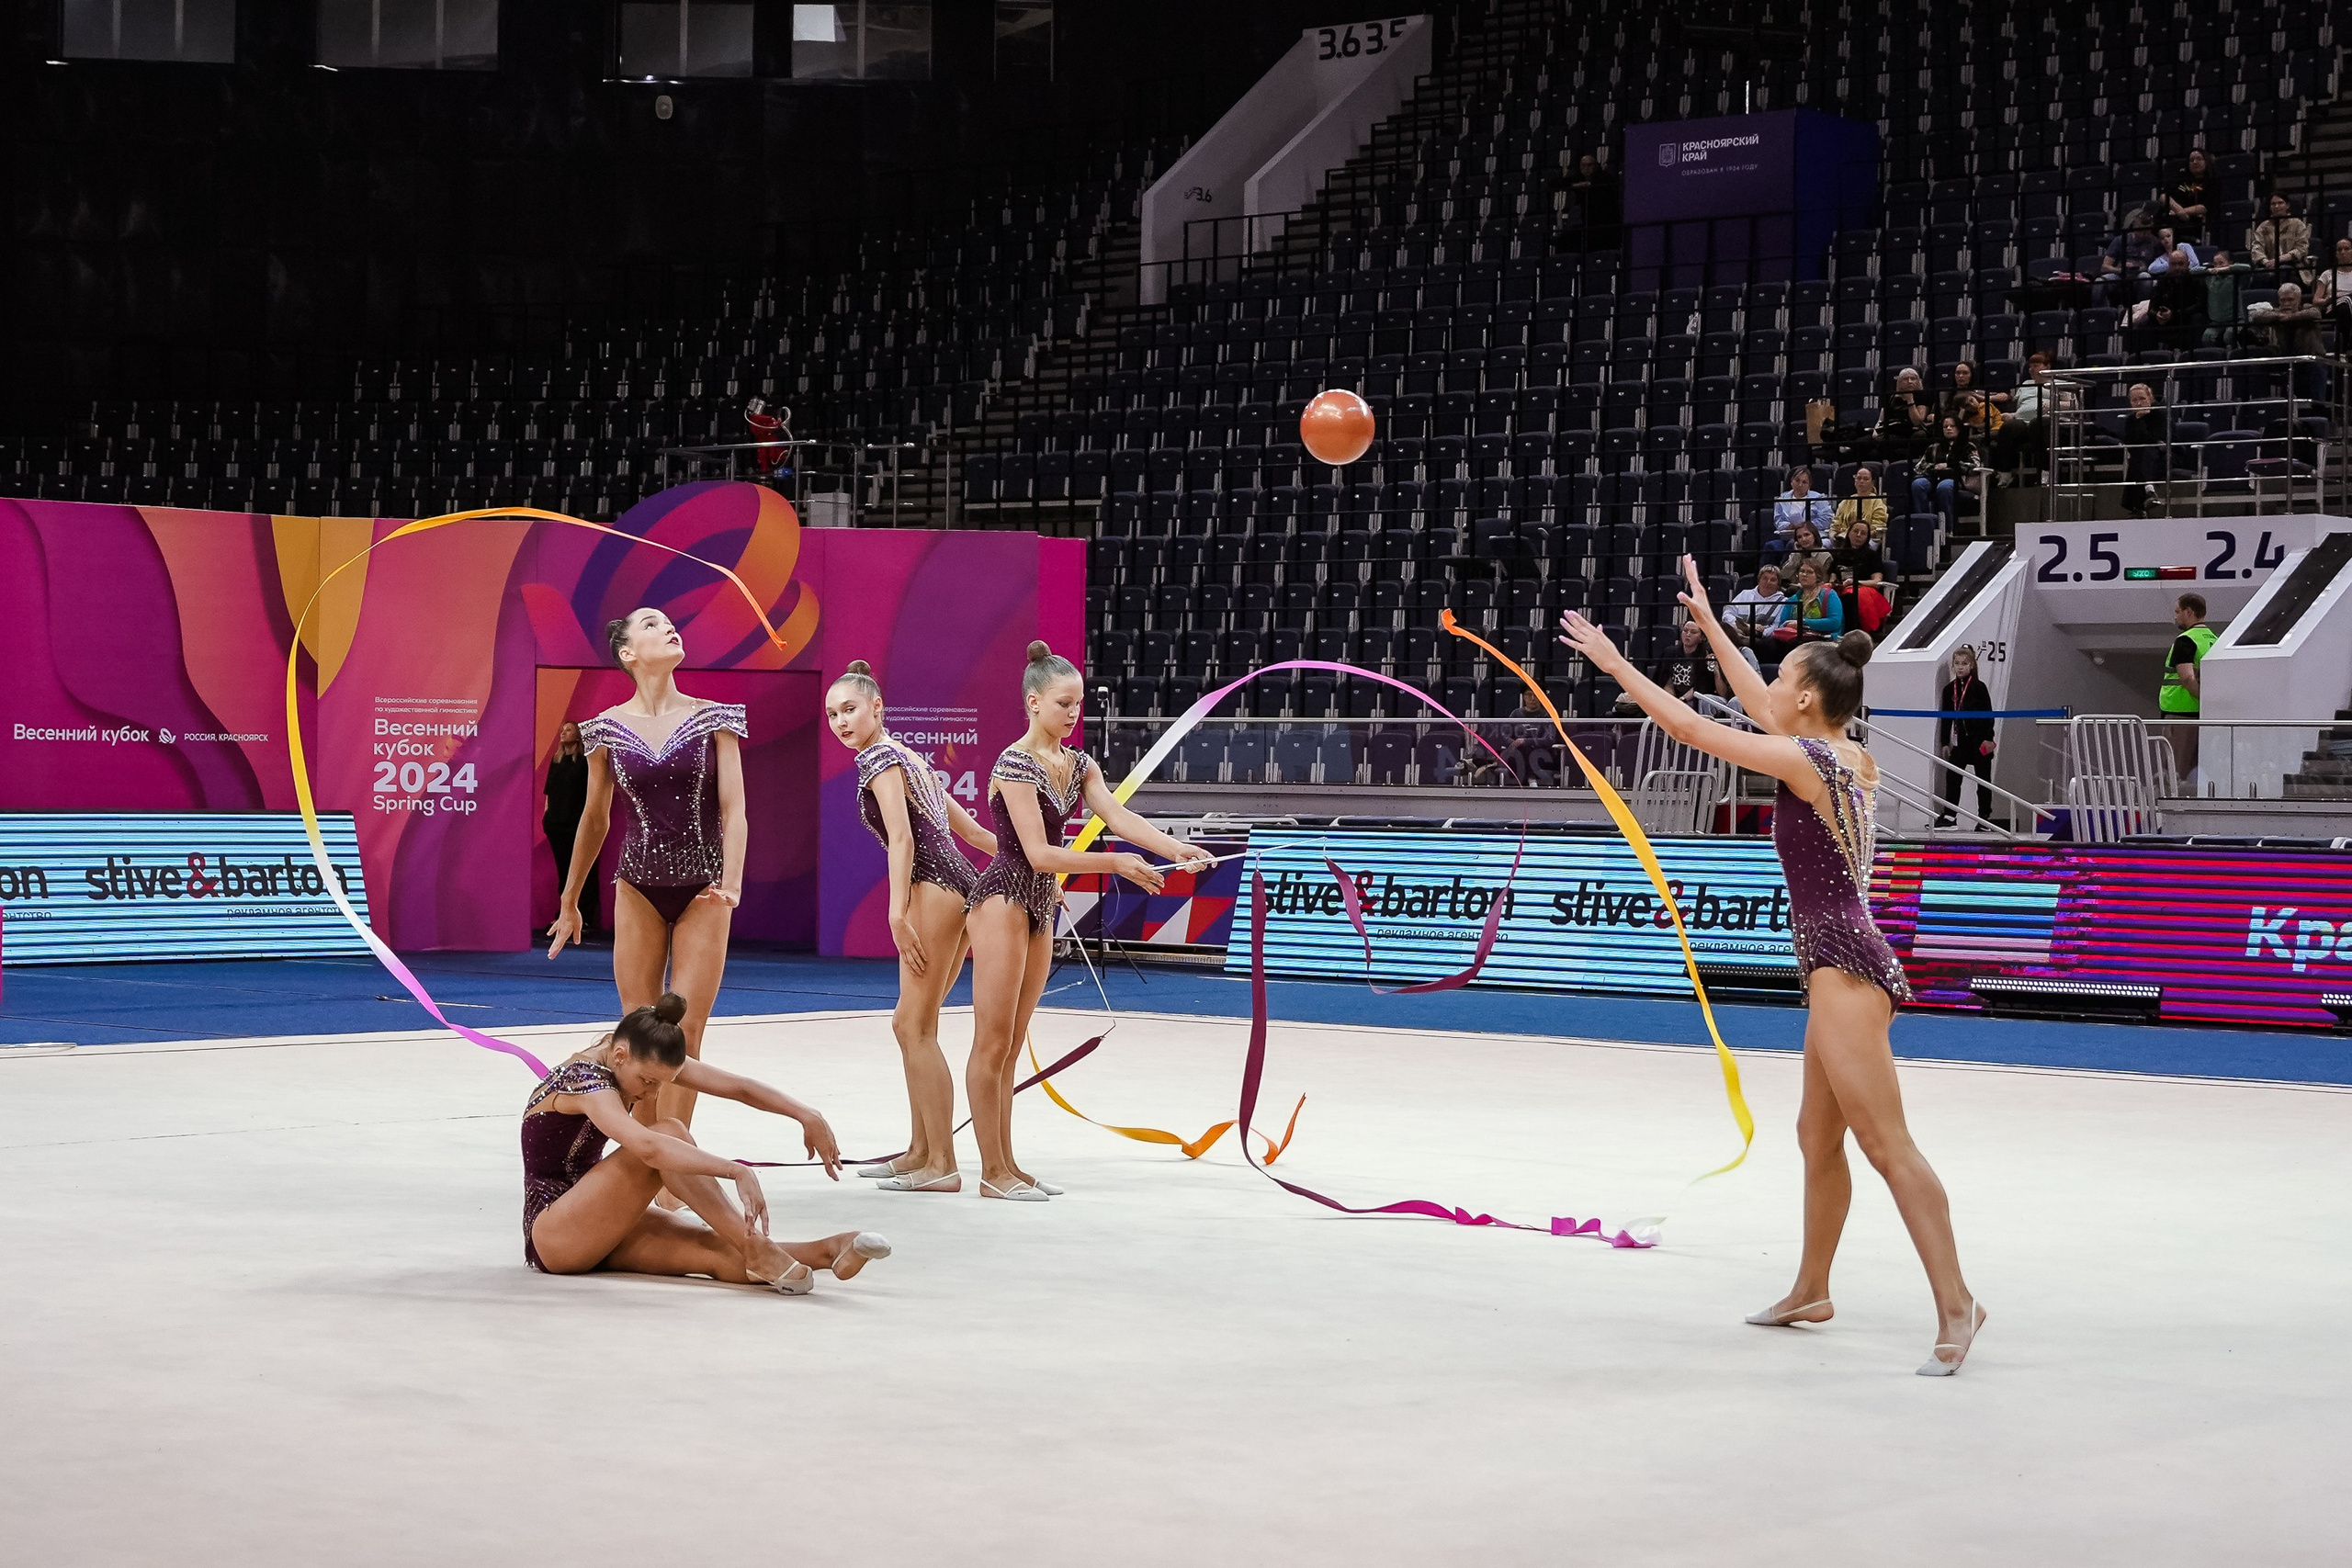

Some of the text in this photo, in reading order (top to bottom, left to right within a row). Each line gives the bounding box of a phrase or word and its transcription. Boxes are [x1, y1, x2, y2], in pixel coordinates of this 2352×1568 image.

[1318, 25, 1361, 61] 3.6
[1682, 133, 1759, 152] КРАСНОЯРСКИЙ
[1681, 150, 1707, 163] КРАЙ
[2037, 532, 2120, 584] 2.5
[2204, 530, 2285, 581] 2.4
[375, 696, 427, 705] Всероссийские
[13, 723, 150, 746] Весенний кубок
[184, 733, 269, 742] РОССИЯ, КРАСНОЯРСК
[374, 717, 478, 737] Весенний
[373, 739, 435, 761] кубок
[373, 761, 479, 794] 2024
[372, 795, 478, 817] Spring Cup
[84, 852, 350, 900] stive&barton
[1549, 879, 1792, 932] stive&bart
